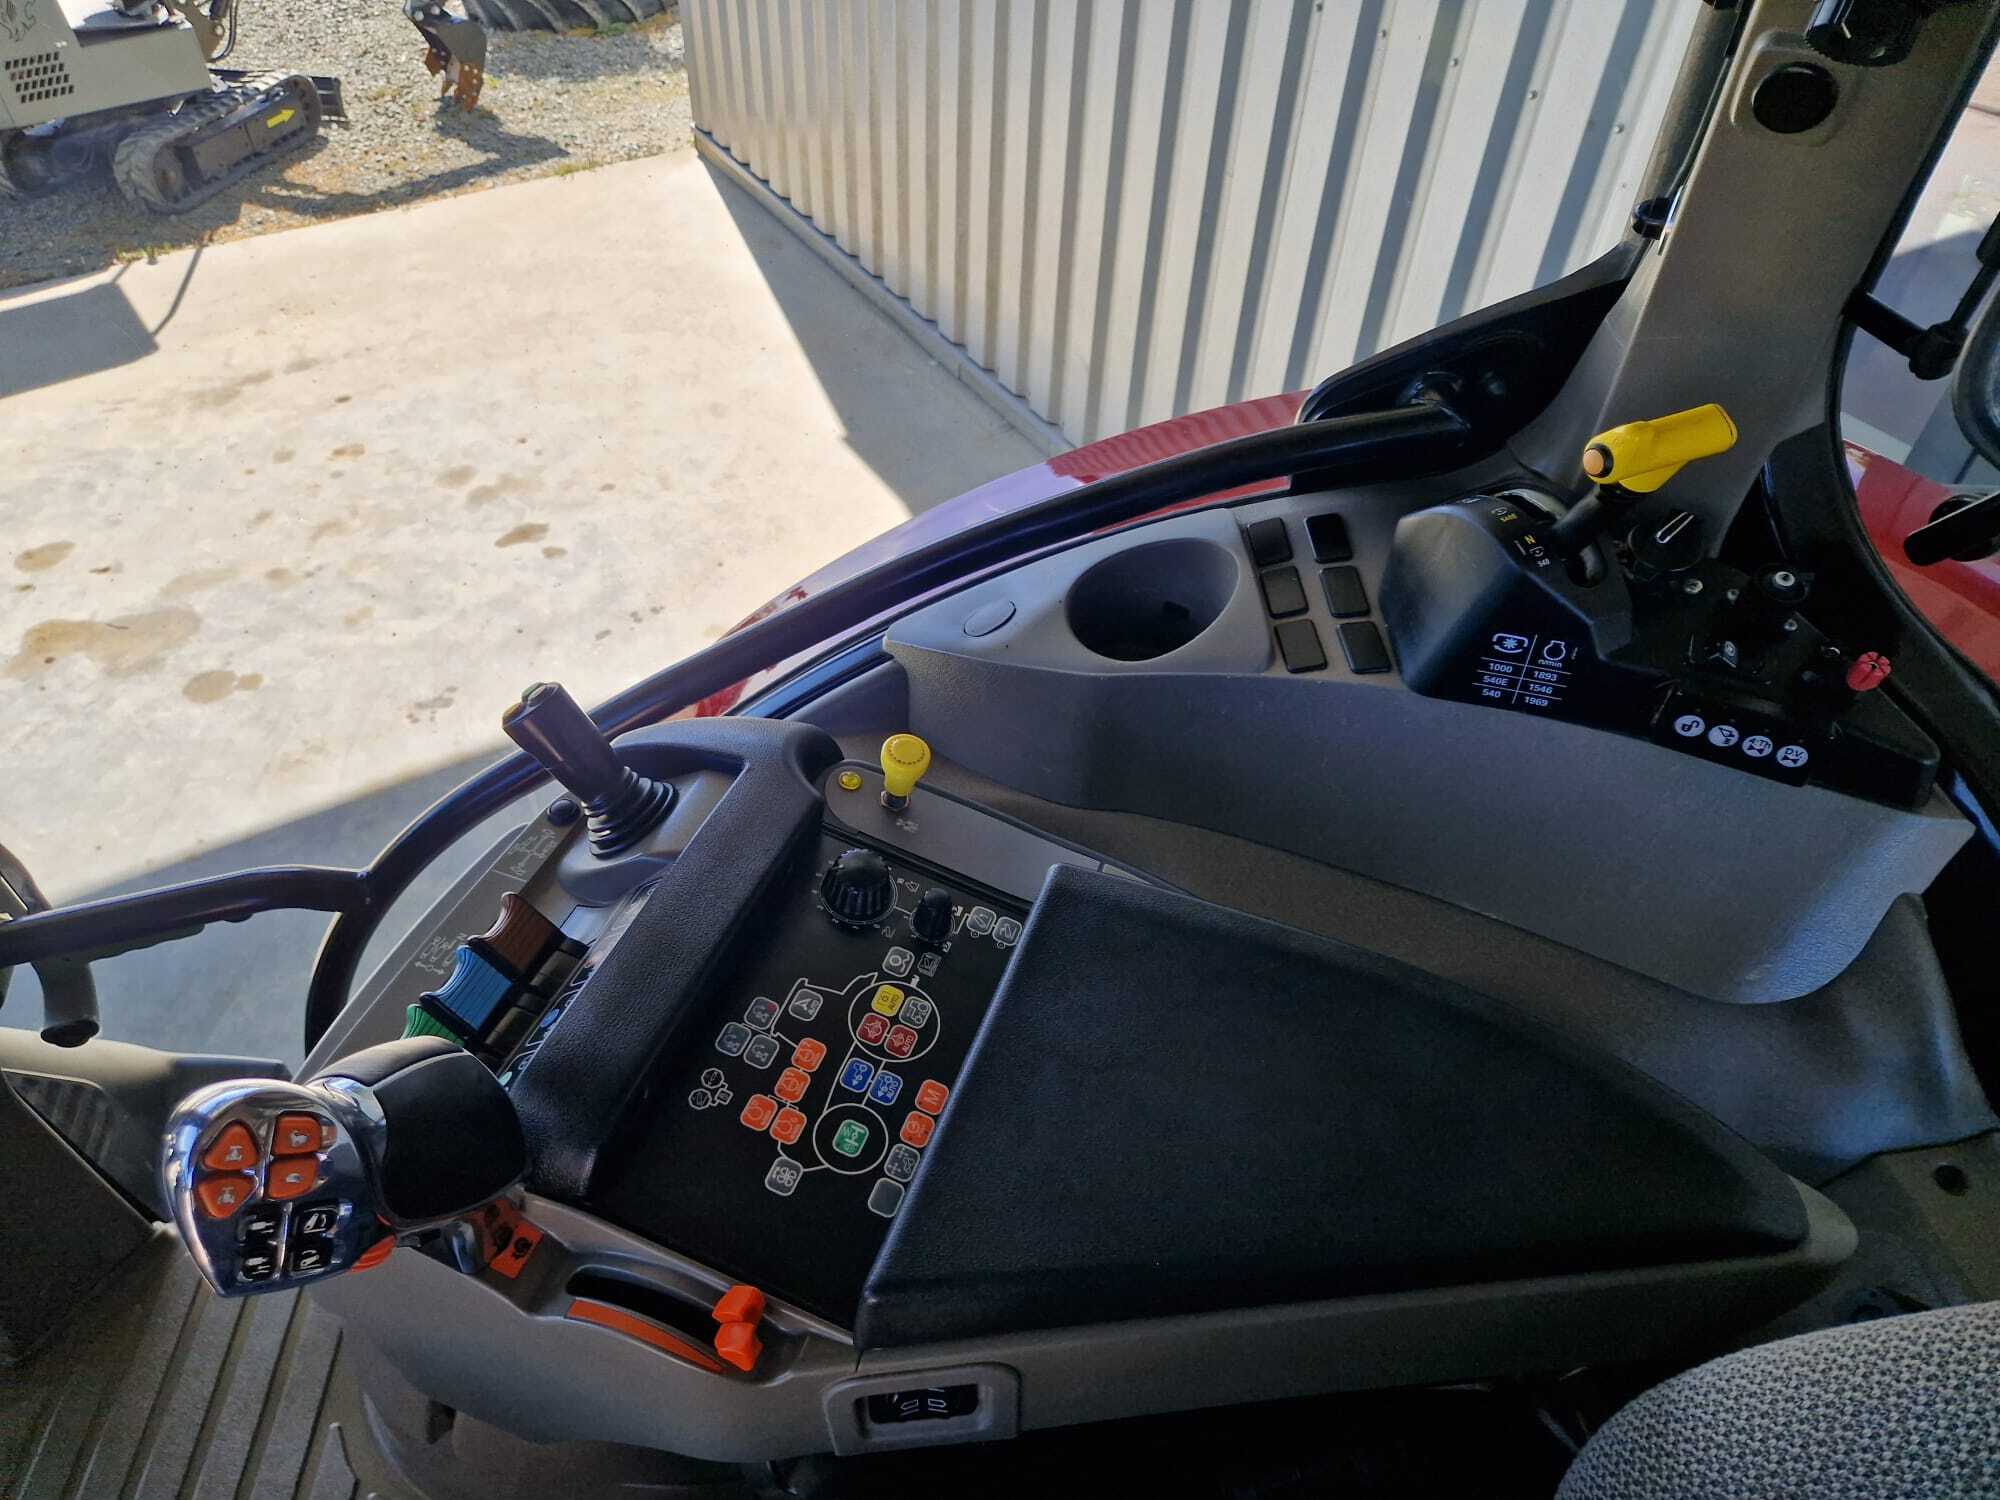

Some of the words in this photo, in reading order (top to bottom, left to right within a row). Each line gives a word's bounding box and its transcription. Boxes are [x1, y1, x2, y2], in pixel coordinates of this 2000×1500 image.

[1488, 662, 1513, 673] 1000
[1482, 675, 1509, 686] 540E
[1533, 670, 1558, 681] 1893
[1481, 688, 1502, 698] 540
[1529, 683, 1553, 695] 1546
[1524, 696, 1549, 707] 1969
